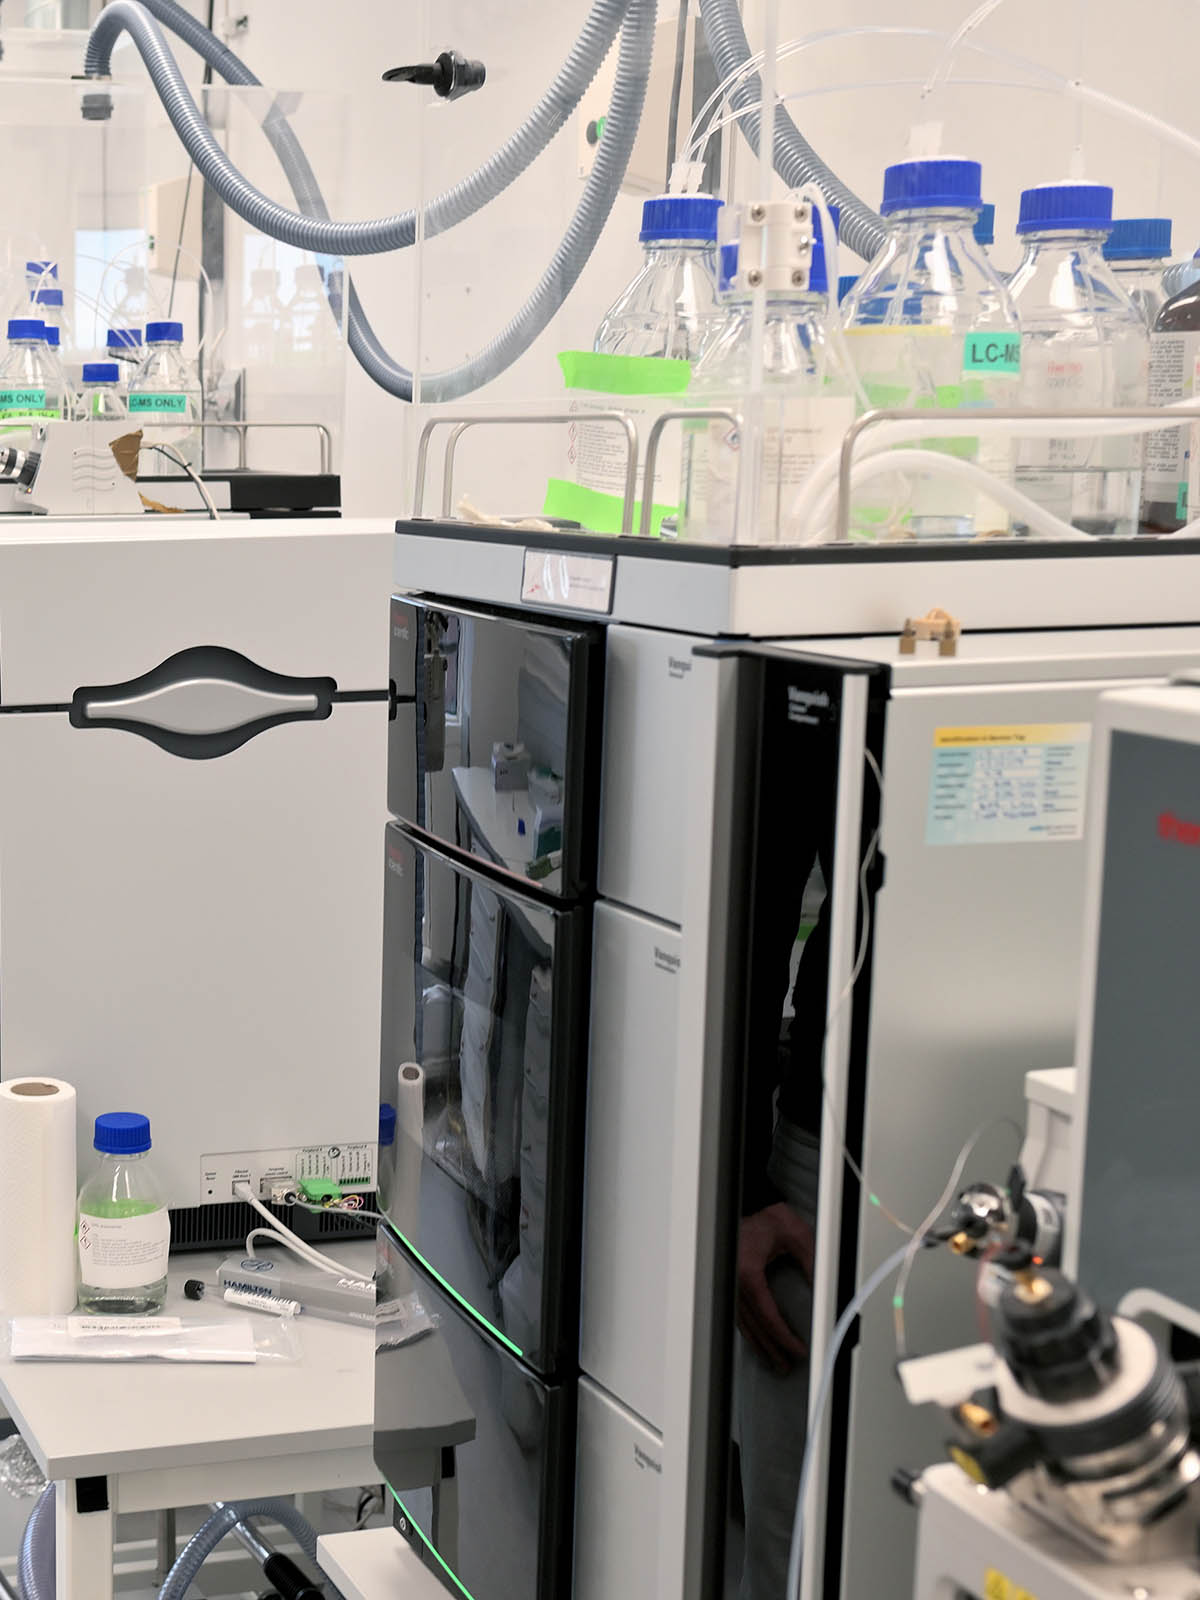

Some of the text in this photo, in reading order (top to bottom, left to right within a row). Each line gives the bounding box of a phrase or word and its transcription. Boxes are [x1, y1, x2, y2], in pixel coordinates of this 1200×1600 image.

[16, 393, 45, 405] ONLY
[155, 397, 184, 408] ONLY
[223, 1279, 273, 1297] HAMILTON
